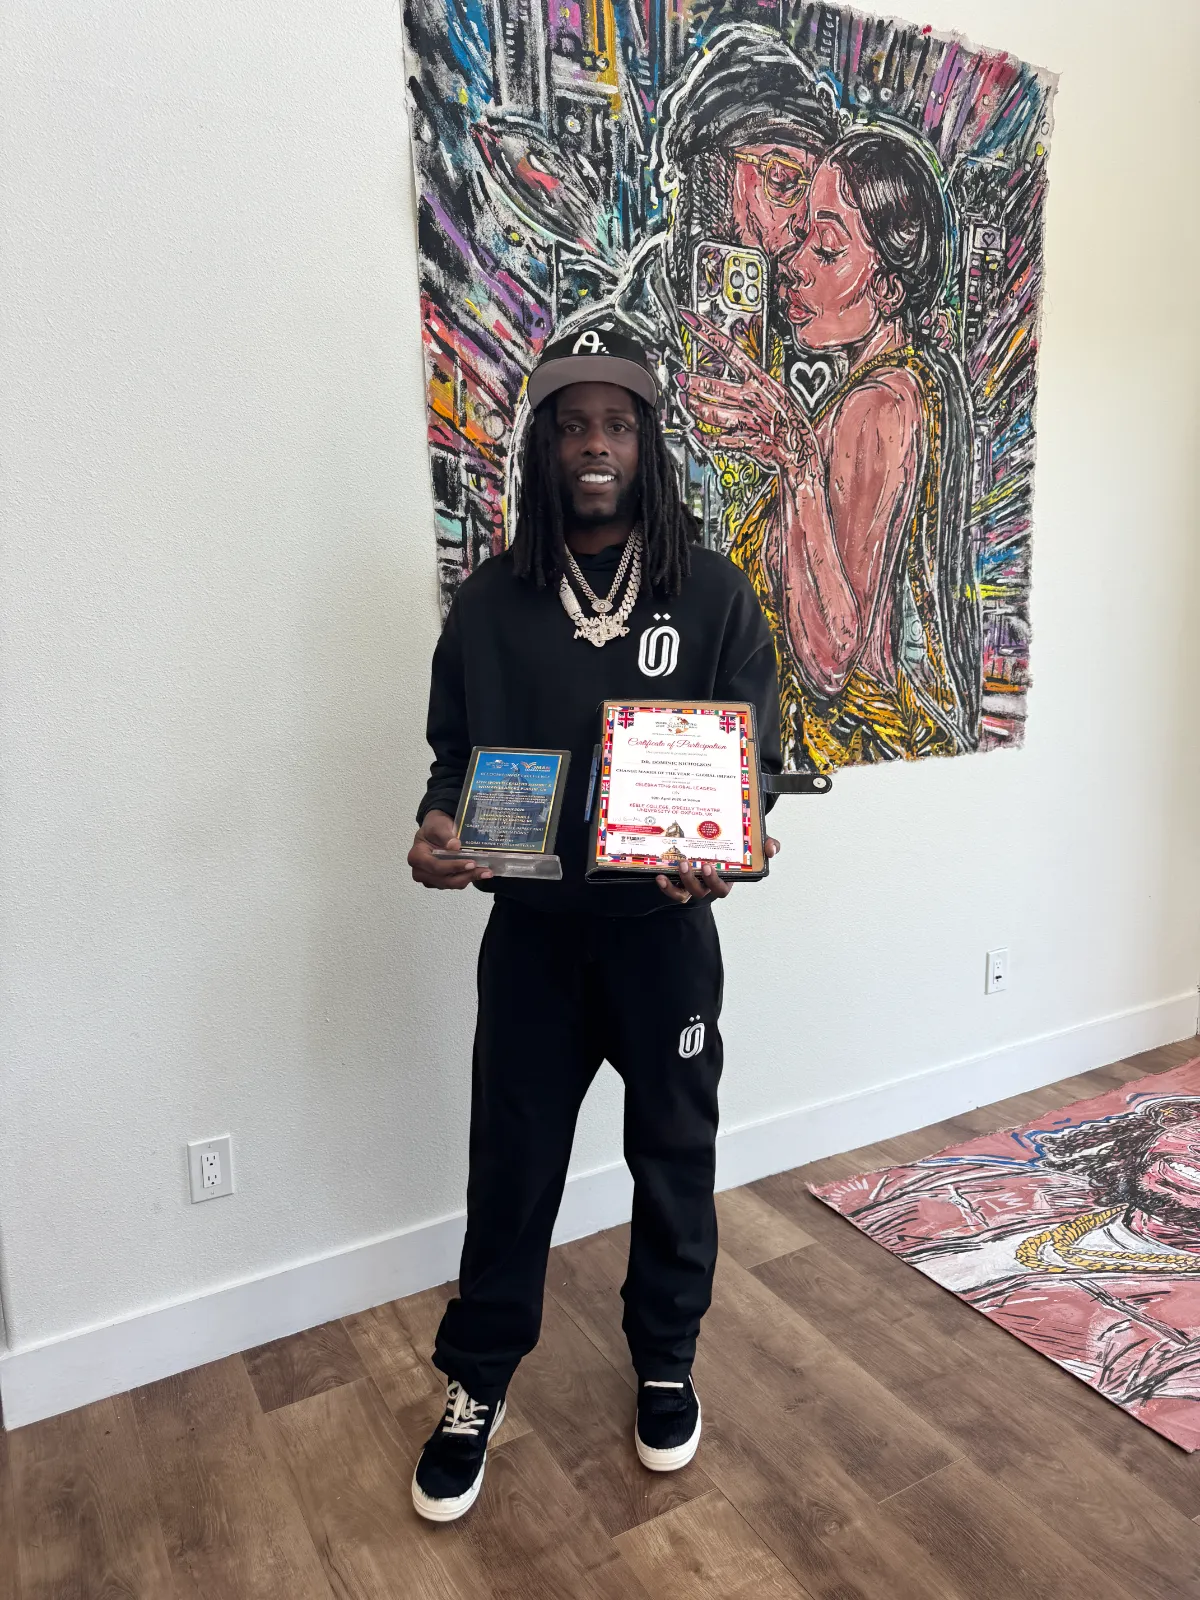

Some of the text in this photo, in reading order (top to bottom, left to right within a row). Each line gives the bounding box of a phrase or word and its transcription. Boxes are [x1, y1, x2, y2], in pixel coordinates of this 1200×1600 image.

[628, 737, 727, 751] Certificate of Participation
